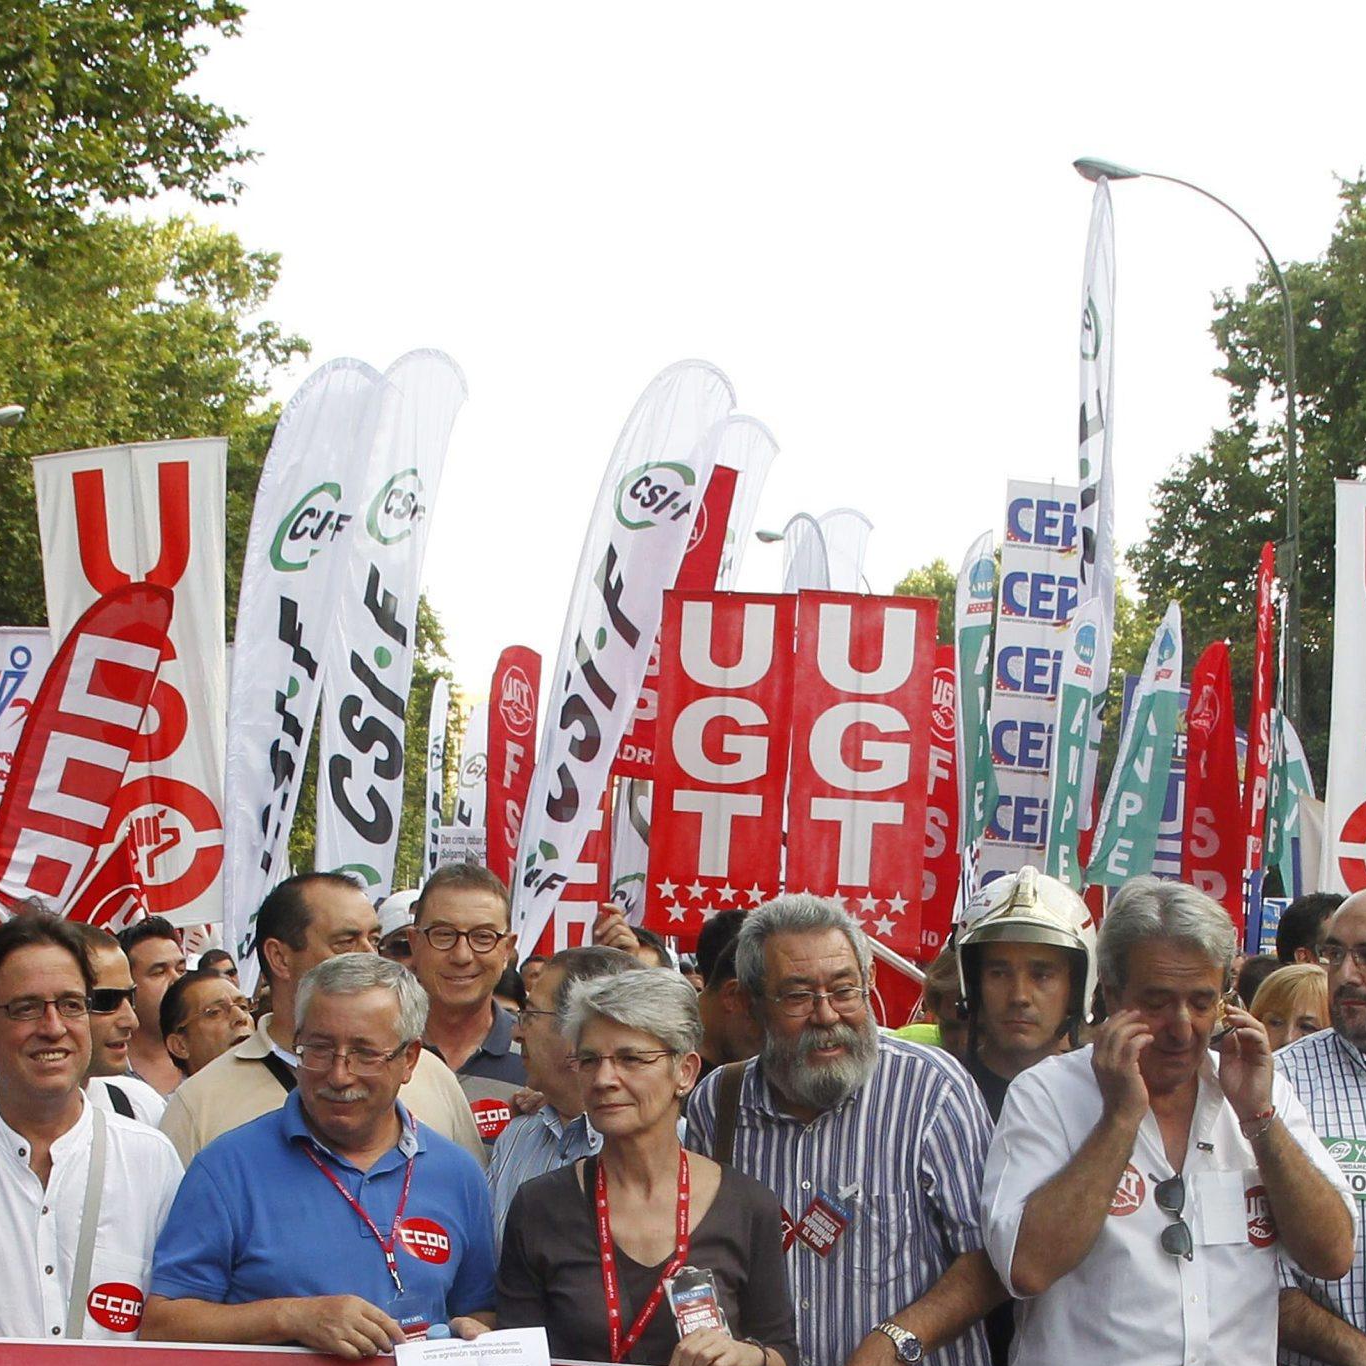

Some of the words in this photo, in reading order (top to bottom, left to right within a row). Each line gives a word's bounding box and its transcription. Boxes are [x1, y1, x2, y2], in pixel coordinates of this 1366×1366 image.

[932, 677, 954, 706] UG
[672, 601, 775, 877] UGT
[809, 604, 917, 887] UGT
[475, 1107, 511, 1124] COO
[400, 1228, 449, 1251] CCOO
